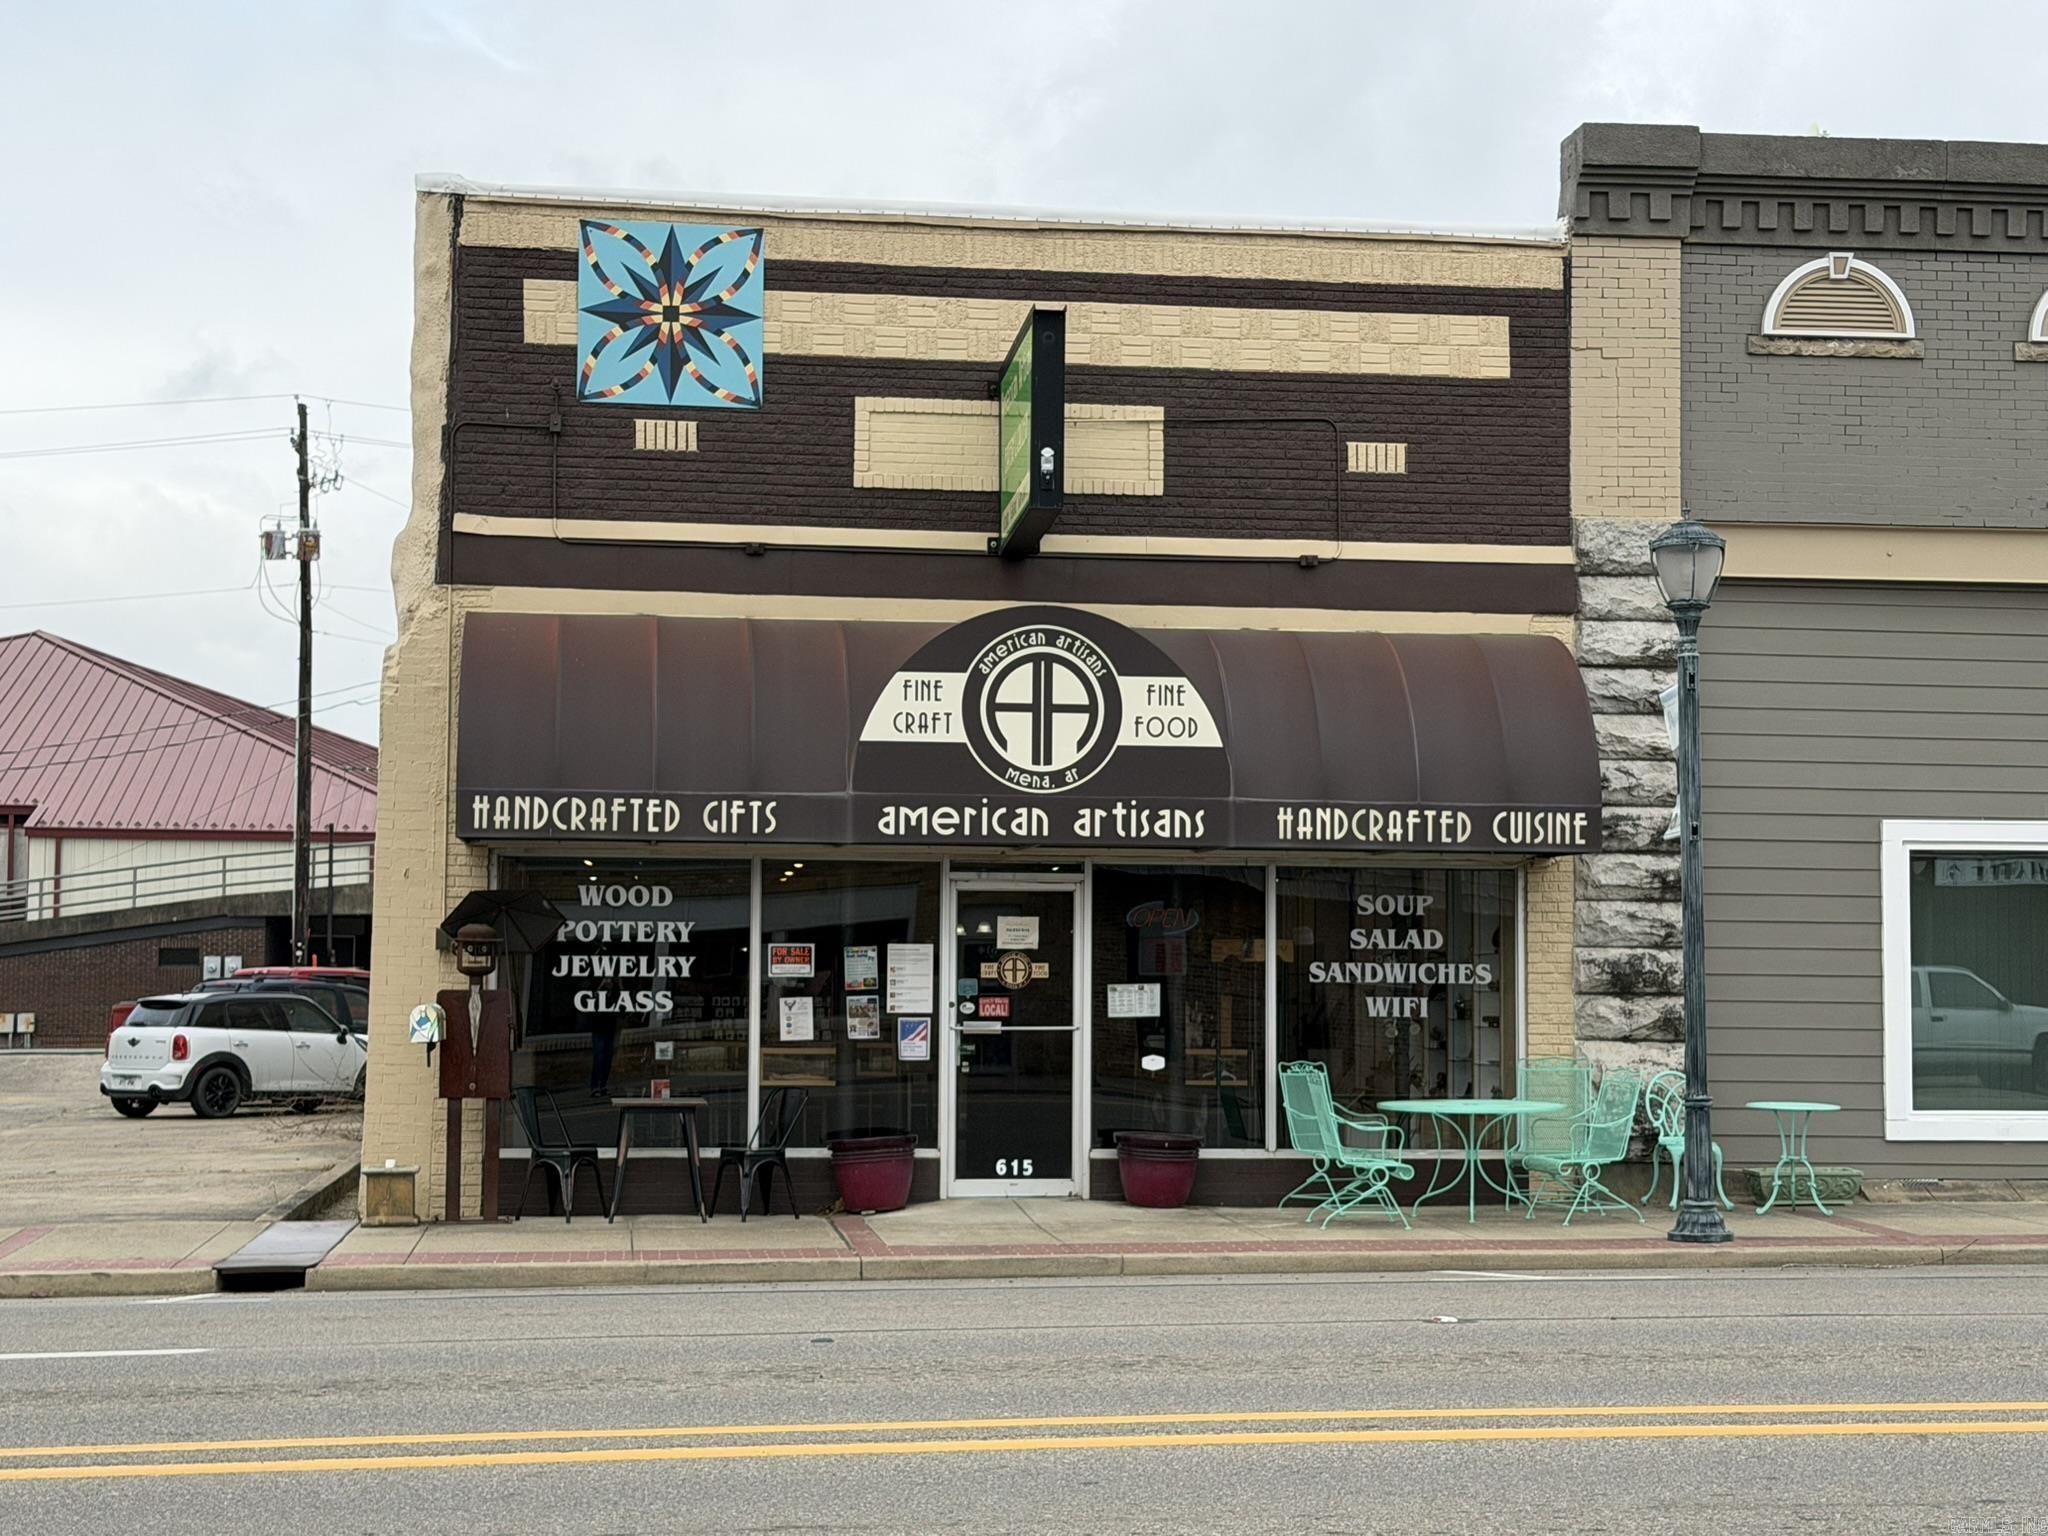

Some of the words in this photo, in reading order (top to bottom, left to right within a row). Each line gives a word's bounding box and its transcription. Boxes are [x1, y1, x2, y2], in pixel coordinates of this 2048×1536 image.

[979, 631, 1046, 675] american
[1055, 634, 1108, 678] artisans
[902, 679, 944, 702] FINE
[1146, 683, 1188, 707] FINE
[892, 711, 953, 735] CRAFT
[1134, 715, 1199, 739] FOOD
[472, 795, 681, 833] HANDCRAFTED
[702, 800, 778, 834] GIFTS
[877, 798, 1049, 837] american
[1073, 799, 1206, 838] artisans
[1276, 806, 1472, 843] HANDCRAFTED
[1492, 811, 1589, 845] CUISINE
[578, 884, 673, 907] WOOD
[1356, 894, 1434, 916] SOUP
[1132, 908, 1194, 928] OPEN
[556, 919, 696, 943] POTTERY
[1350, 928, 1444, 950] SALAD
[772, 947, 788, 956] FOR
[790, 947, 810, 956] SALE
[551, 955, 697, 978] JEWELRY
[1308, 961, 1493, 985] SANDWICHES
[573, 990, 674, 1013] GLASS
[1365, 996, 1429, 1018] WIFI
[995, 1158, 1034, 1177] 615
